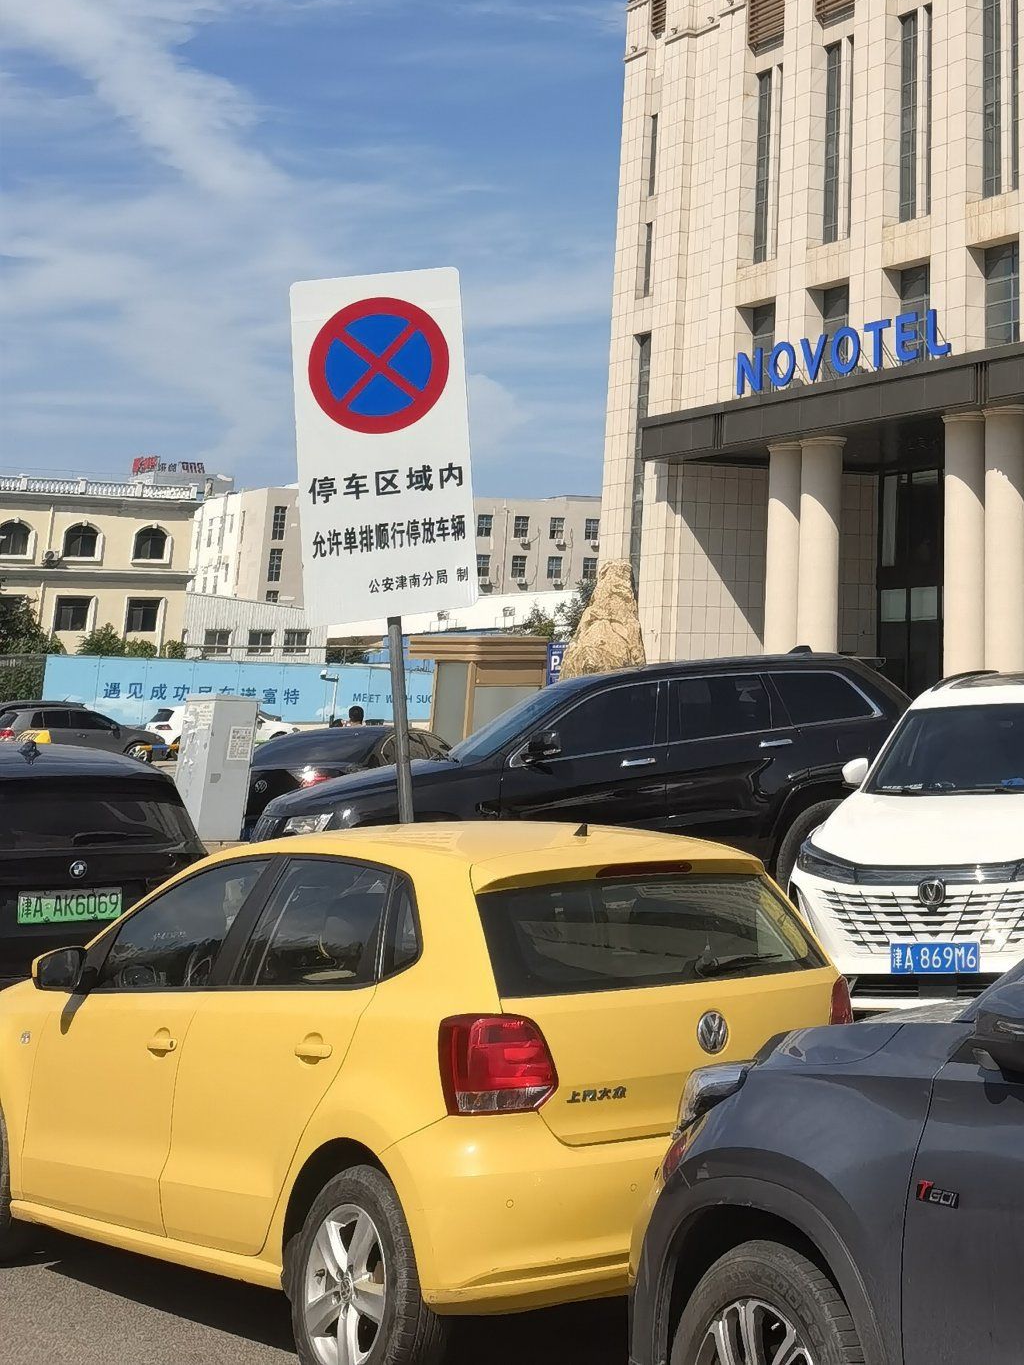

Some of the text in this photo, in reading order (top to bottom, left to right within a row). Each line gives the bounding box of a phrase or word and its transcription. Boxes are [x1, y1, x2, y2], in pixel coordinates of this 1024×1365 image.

[736, 308, 951, 396] NOVOTEL
[308, 462, 463, 504] 停车区域内
[312, 514, 466, 559] 允许单排顺行停放车辆
[368, 566, 469, 594] 公安津南分局 制
[352, 693, 381, 703] MEET
[385, 694, 413, 704] WH
